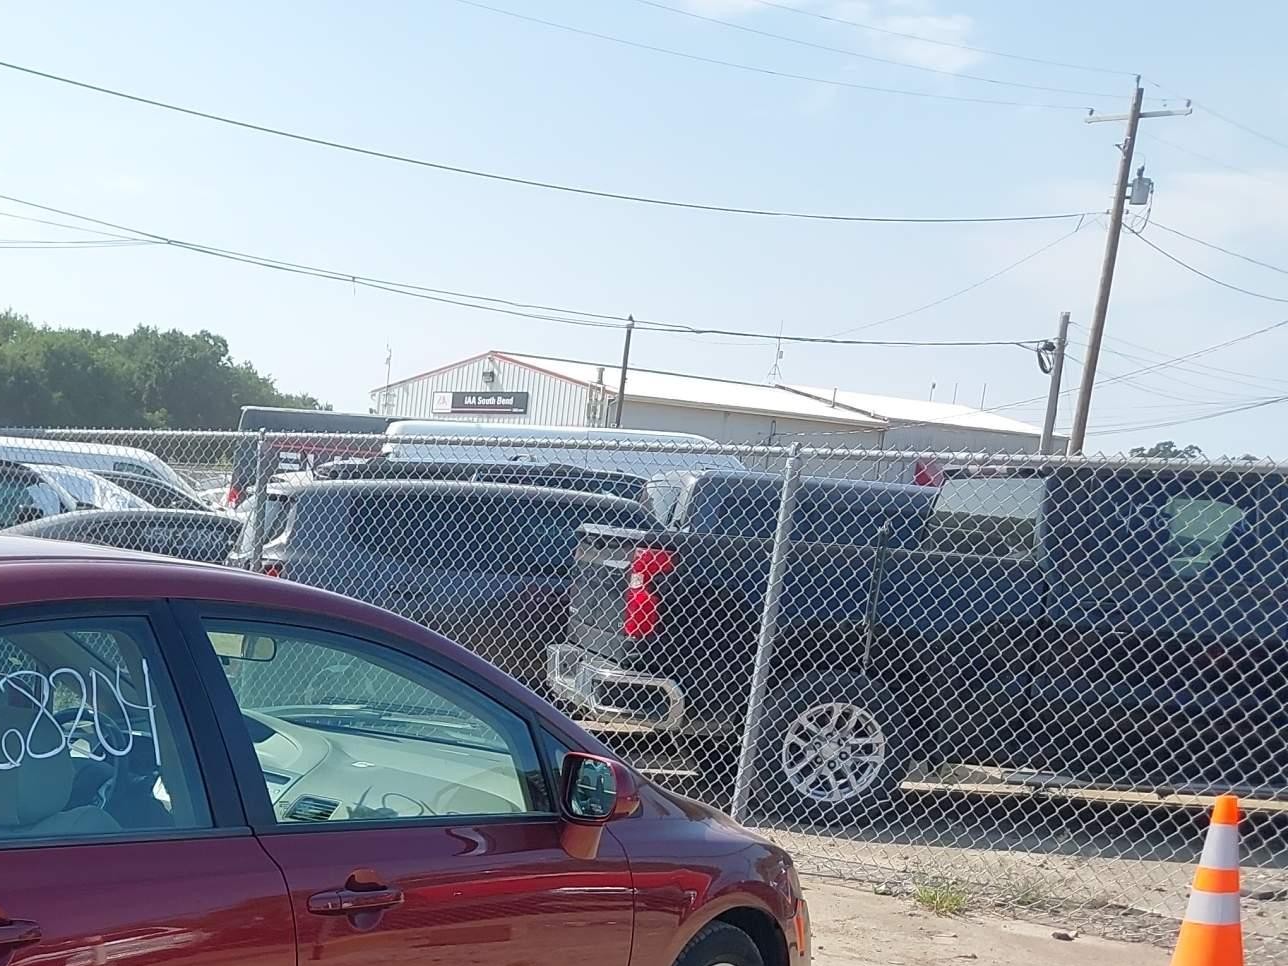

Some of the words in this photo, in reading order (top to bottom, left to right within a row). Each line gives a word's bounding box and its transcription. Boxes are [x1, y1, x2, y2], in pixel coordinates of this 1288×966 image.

[464, 396, 477, 405] IAA
[478, 396, 496, 405] South
[496, 396, 514, 405] Bend
